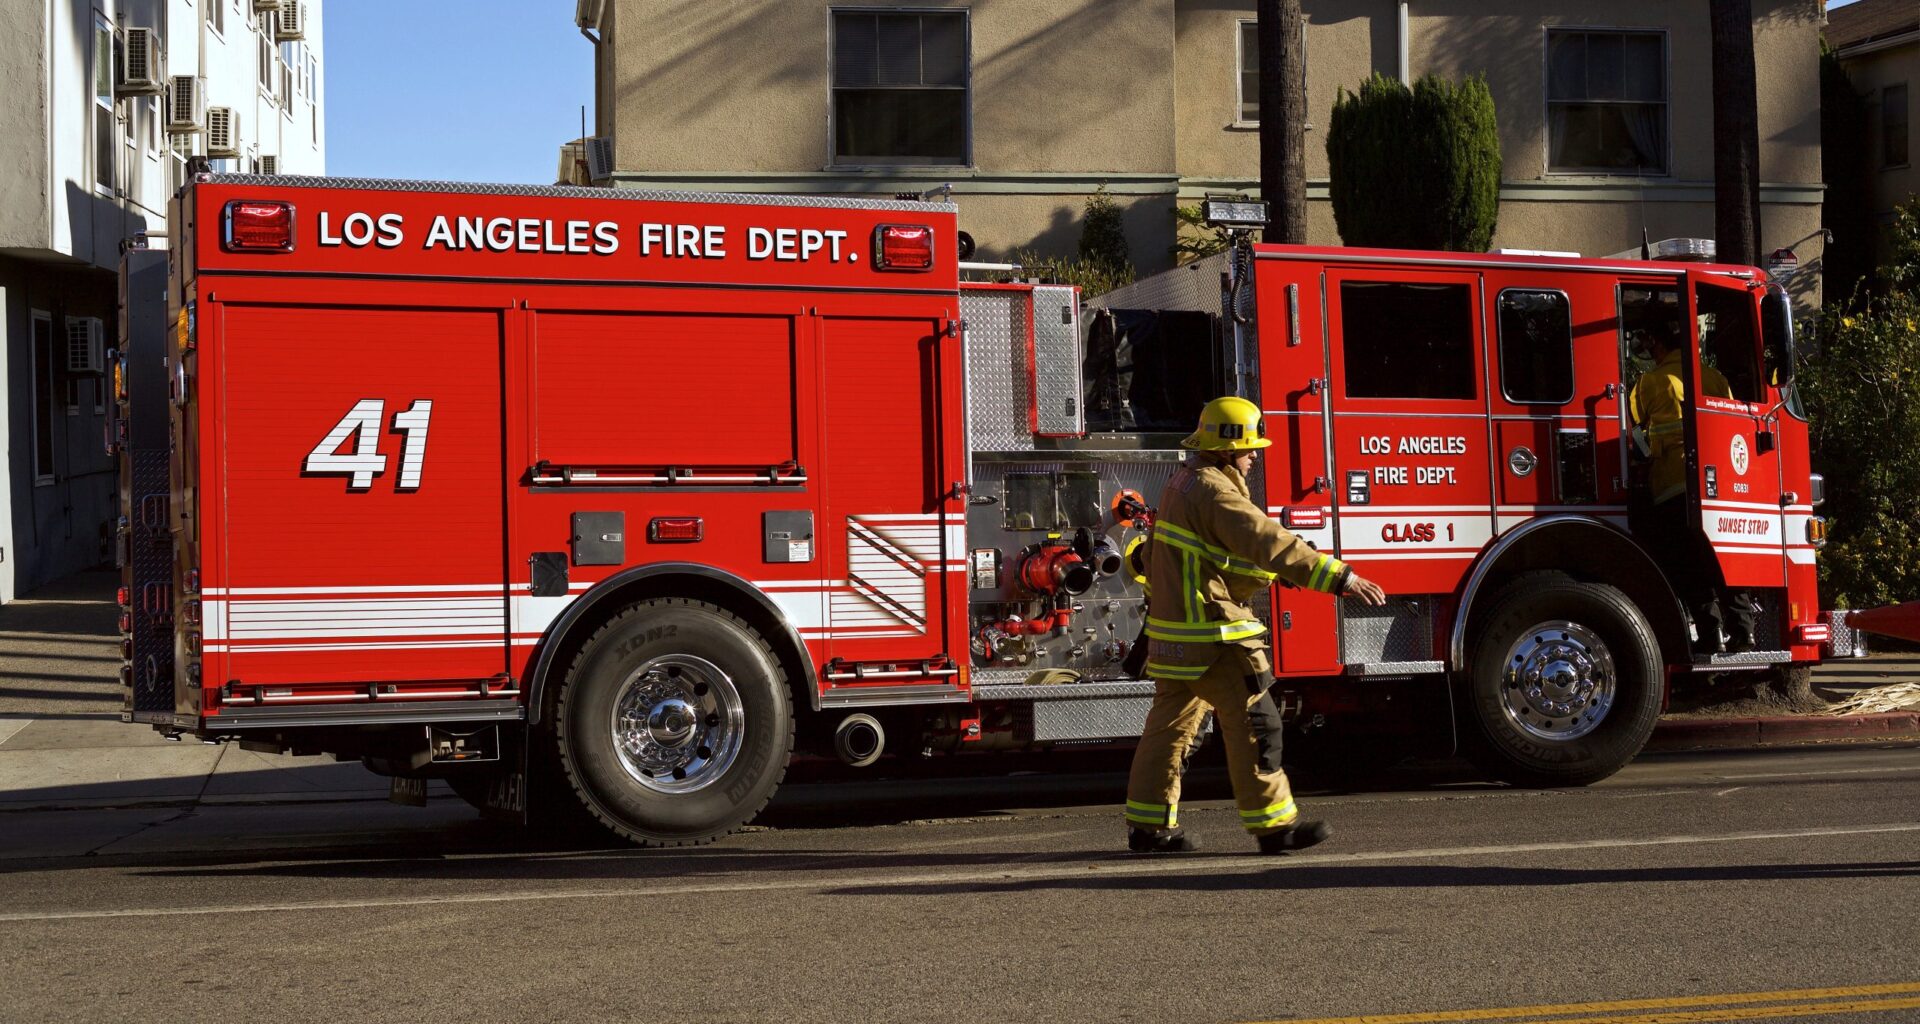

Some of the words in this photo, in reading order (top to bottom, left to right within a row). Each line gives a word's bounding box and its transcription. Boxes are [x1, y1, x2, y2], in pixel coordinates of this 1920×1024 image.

[318, 211, 404, 247] LOS
[424, 215, 619, 254] ANGELES
[641, 223, 727, 257] FIRE
[747, 227, 858, 262] DEPT.
[1223, 425, 1239, 439] 41
[301, 398, 433, 493] 41
[1360, 436, 1391, 454] LOS
[1398, 436, 1466, 454] ANGELES
[1374, 466, 1408, 485] FIRE
[1416, 466, 1456, 485] DEPT.
[1733, 482, 1749, 493] 60831
[1381, 523, 1435, 543] CLASS
[1446, 523, 1455, 542] 1
[1718, 517, 1747, 534] SUNSET
[1747, 519, 1769, 535] STRIP
[614, 624, 678, 663] XDN2
